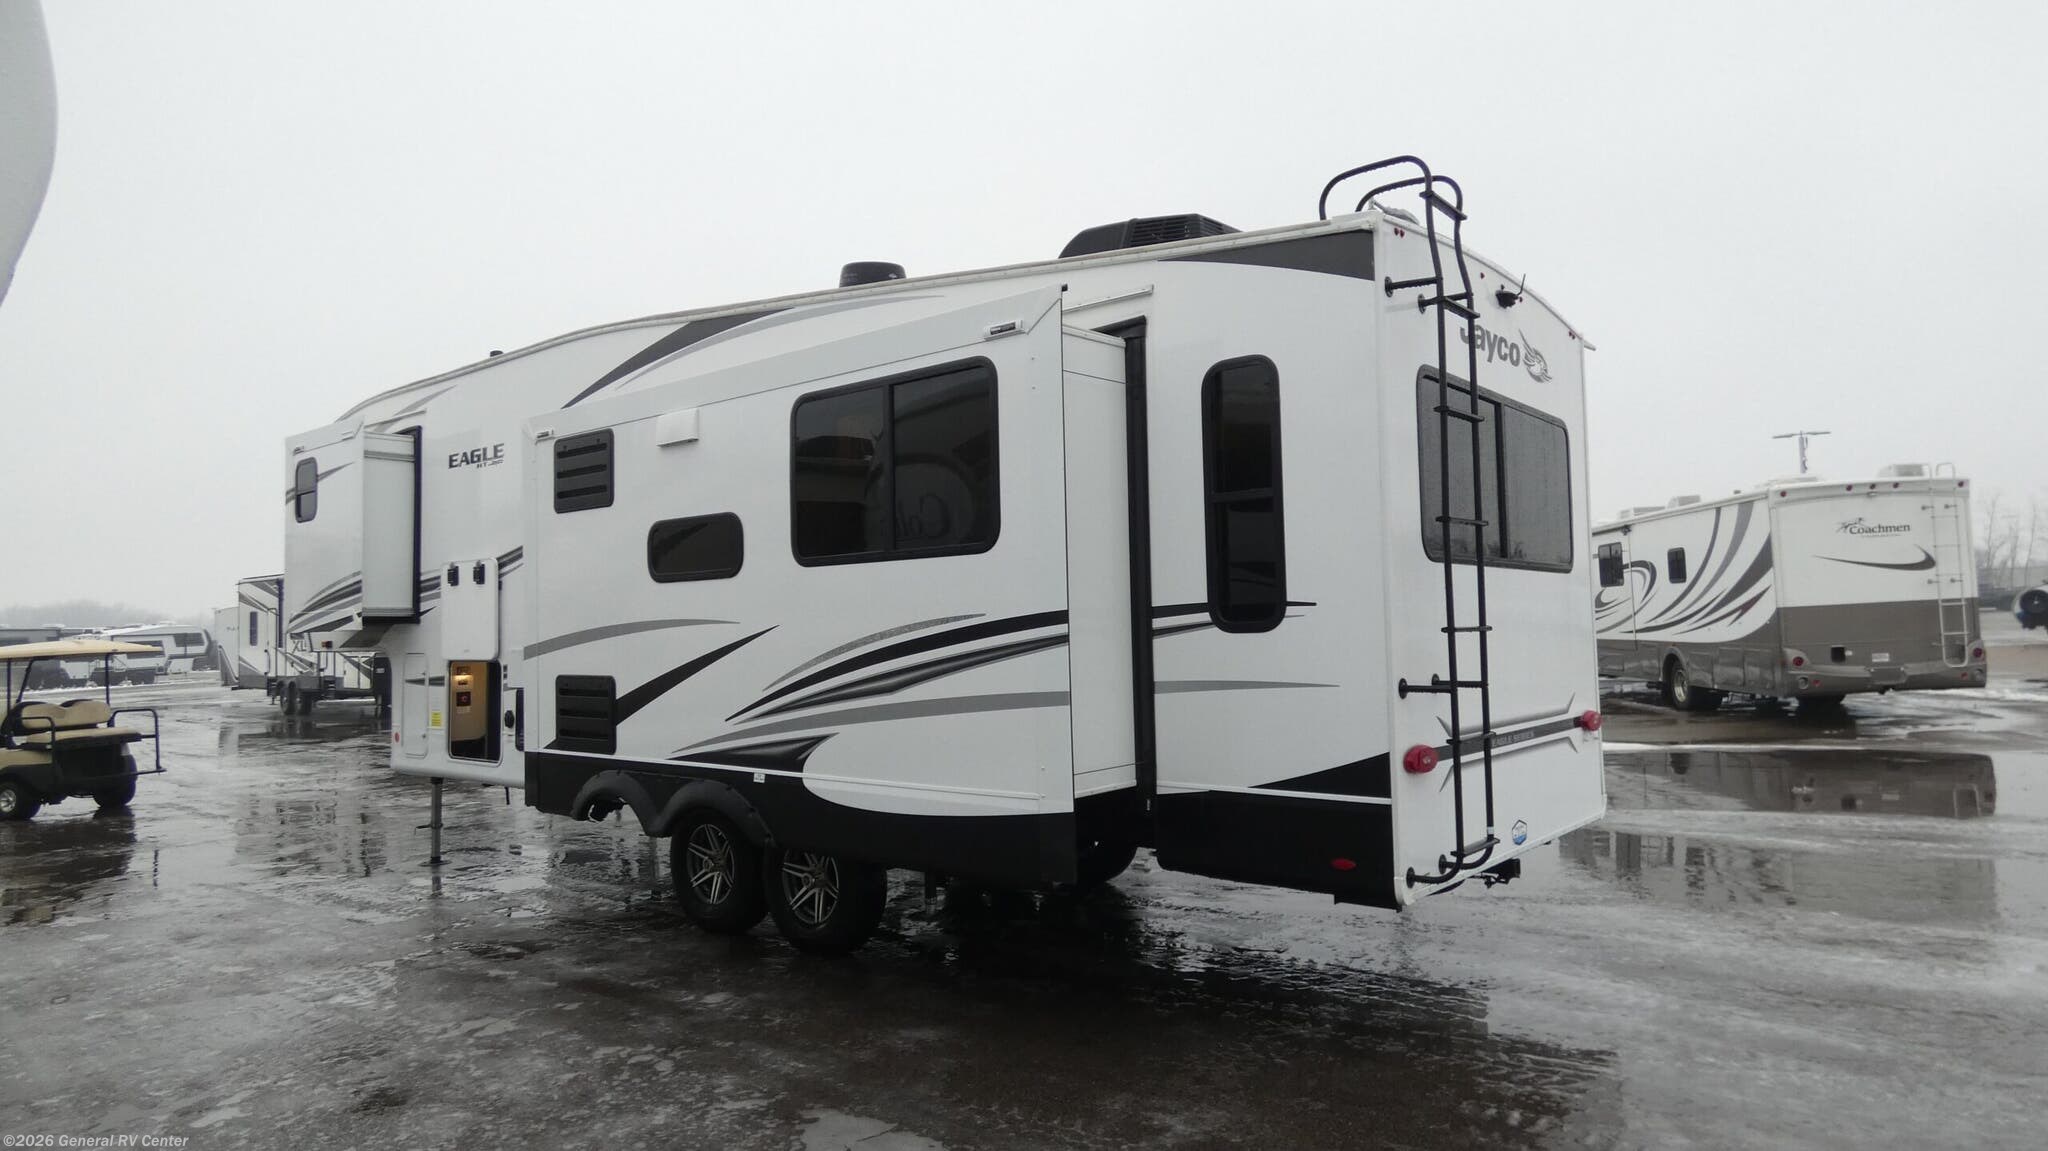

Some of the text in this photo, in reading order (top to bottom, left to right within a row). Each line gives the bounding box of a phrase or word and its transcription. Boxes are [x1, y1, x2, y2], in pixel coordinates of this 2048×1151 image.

[448, 442, 504, 469] EAGLE
[1848, 523, 1911, 535] Coachmen
[1492, 734, 1513, 747] EAGLE
